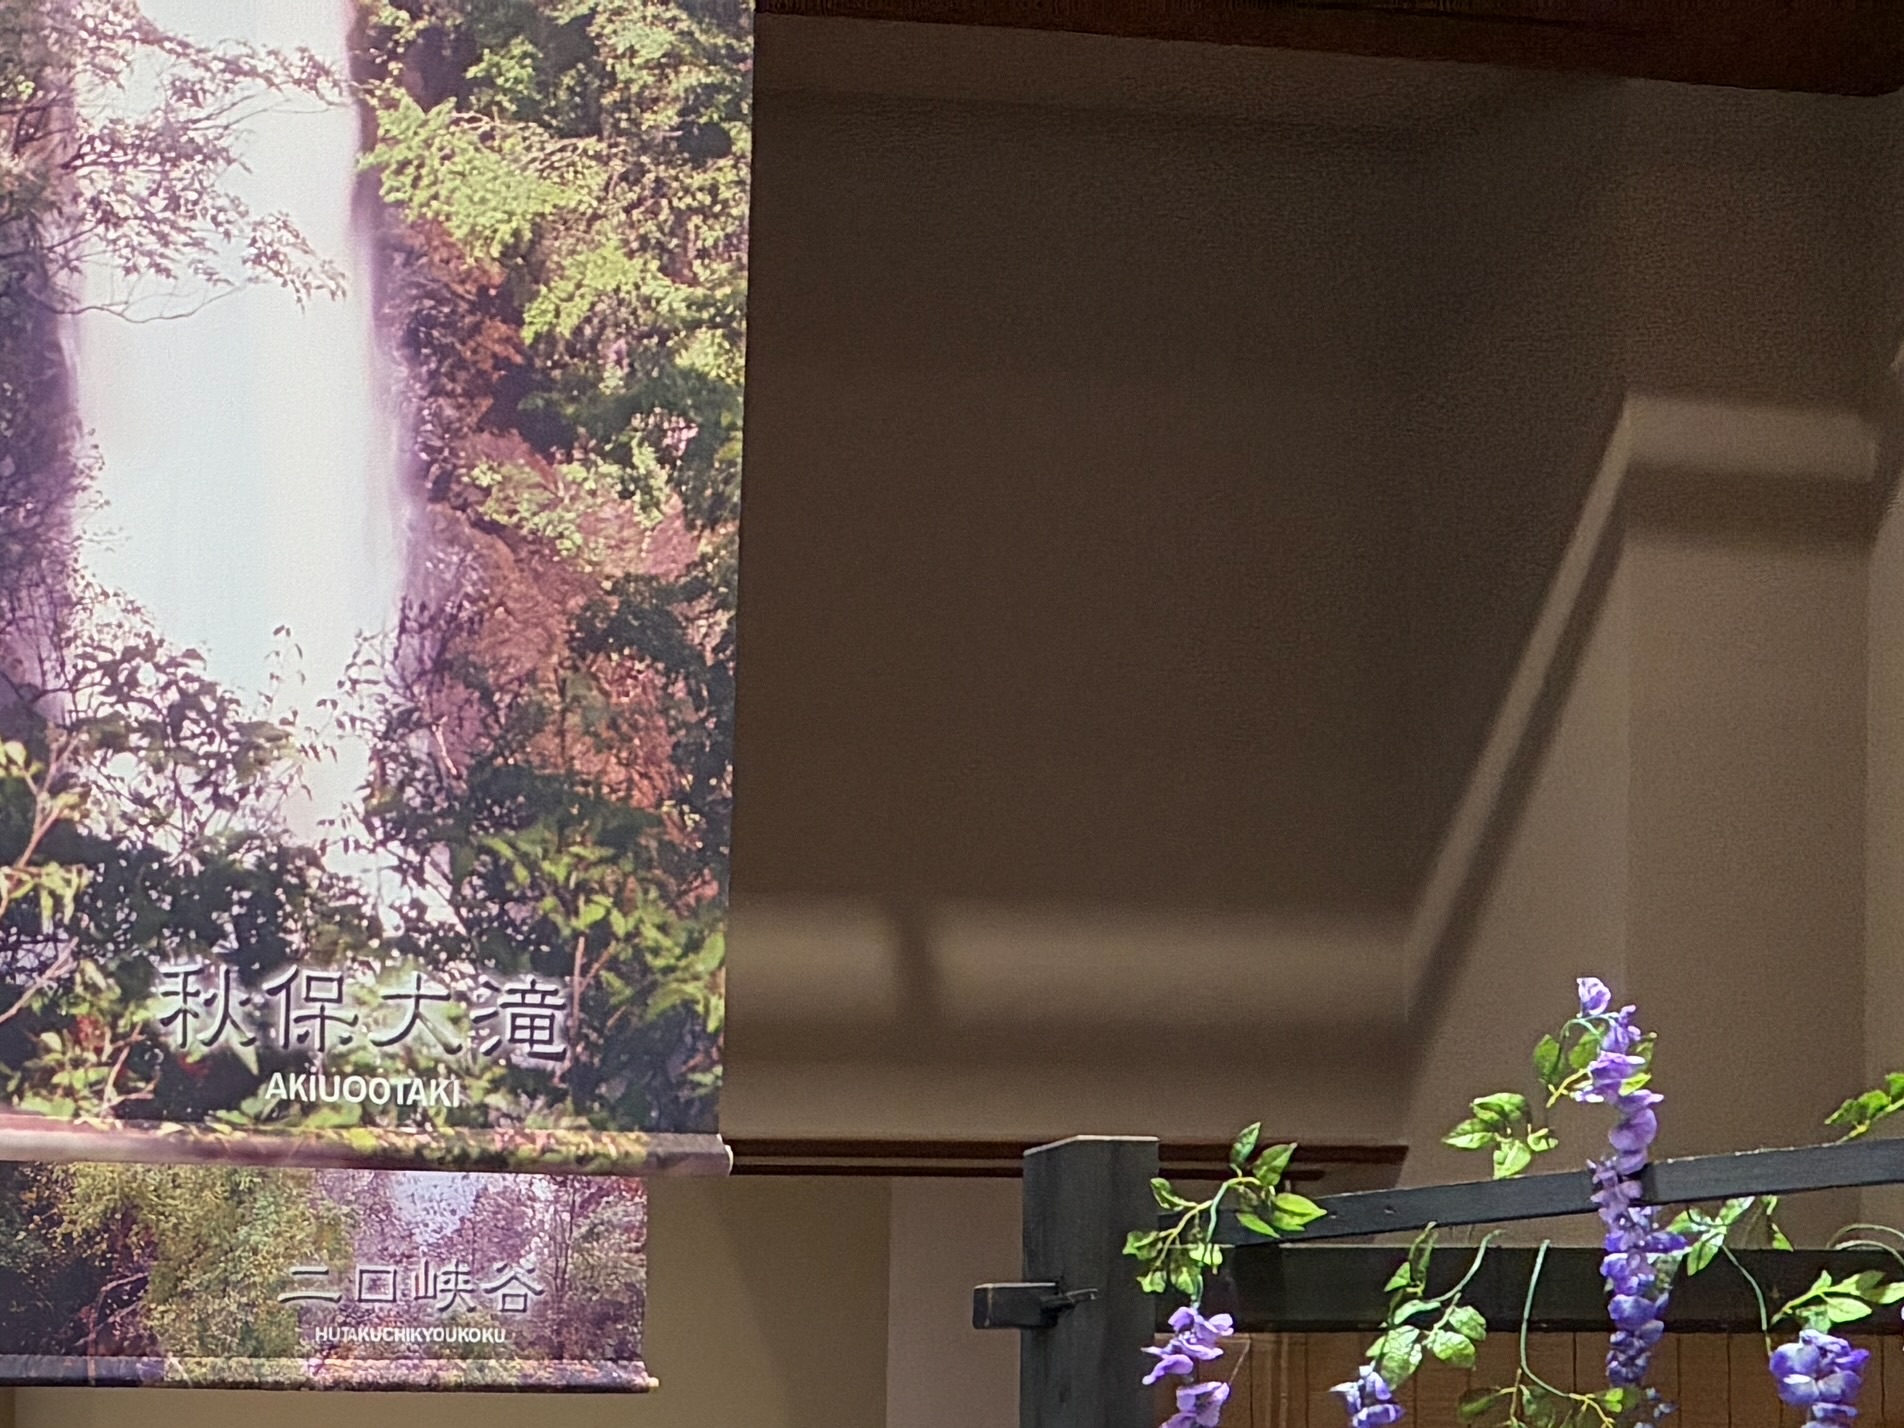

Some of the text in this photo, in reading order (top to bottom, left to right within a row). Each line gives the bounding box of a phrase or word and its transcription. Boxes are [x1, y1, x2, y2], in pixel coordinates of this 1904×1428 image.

[159, 961, 569, 1061] 秋保大滝
[265, 1071, 461, 1109] AKIUOOTAKI
[279, 1258, 546, 1314] 二口峡谷
[314, 1325, 507, 1344] HUTAKUCHIKYOUKOKU
